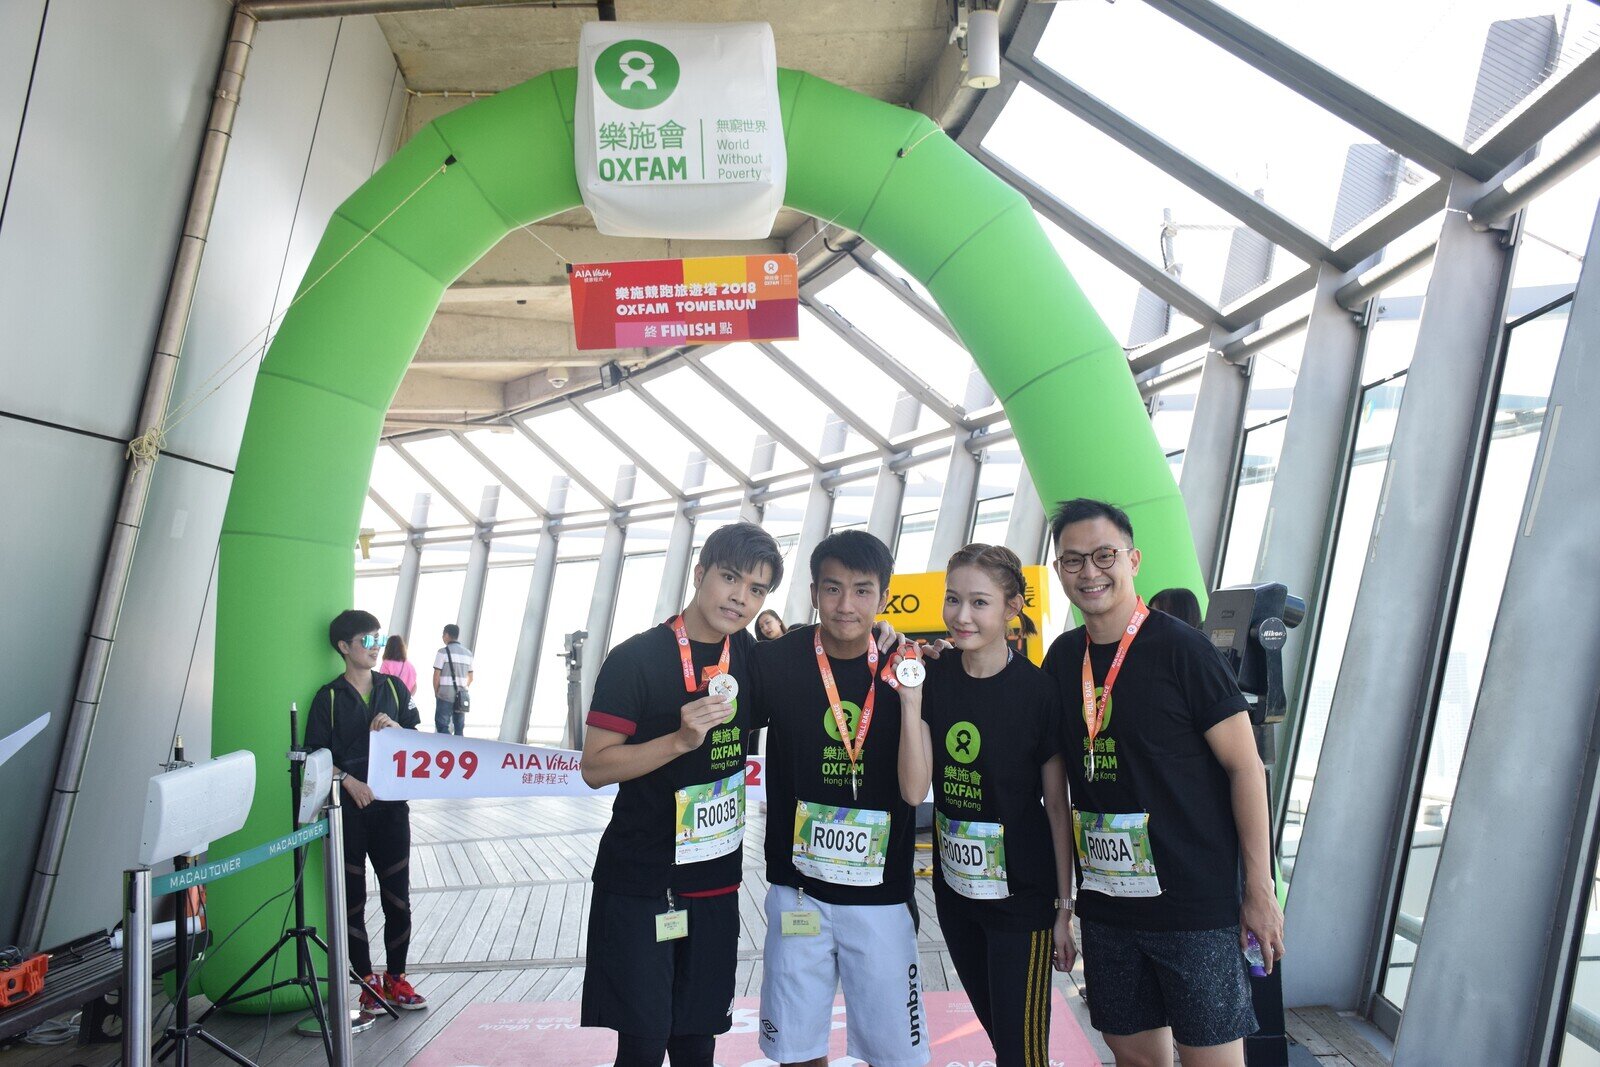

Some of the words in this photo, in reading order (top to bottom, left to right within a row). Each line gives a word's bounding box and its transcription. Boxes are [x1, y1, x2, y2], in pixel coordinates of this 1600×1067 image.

[599, 119, 687, 151] 樂施會
[716, 118, 768, 134] 無窮世界
[717, 139, 750, 150] World
[717, 153, 763, 165] Without
[599, 156, 687, 182] OXFAM
[718, 167, 762, 181] Poverty
[575, 270, 592, 278] AIA
[615, 282, 717, 300] 樂施競跑旅遊塔
[722, 282, 756, 294] 2018
[616, 303, 669, 316] OXFAM
[676, 299, 756, 313] TOWERRUN
[644, 326, 656, 338] 終
[661, 323, 716, 337] FINISH
[720, 322, 732, 334] 點
[1102, 685, 1110, 702] RACE
[833, 703, 842, 720] RACE
[857, 724, 866, 740] FULL
[862, 708, 870, 724] RACE
[712, 726, 740, 745] 樂施會
[711, 743, 742, 760] OXFAM
[393, 750, 478, 780] 1299
[501, 753, 541, 770] AIA
[546, 753, 582, 771] Vitali
[711, 762, 726, 770] Hong
[1084, 755, 1117, 769] OFAM
[522, 773, 568, 785] 健康程式
[745, 761, 761, 785] 2
[824, 777, 842, 786] Hong
[944, 766, 982, 786] 樂施會
[1100, 772, 1116, 782] Kong
[944, 782, 982, 800] OXFAM
[946, 796, 962, 808] Hong
[963, 800, 981, 812] Kong
[697, 798, 736, 829] R003B
[270, 836, 297, 854] MACAU
[298, 824, 324, 842] TOWER
[814, 826, 868, 854] R003C
[943, 837, 983, 866] R003D
[1088, 836, 1132, 862] R003A
[170, 867, 207, 888] MACAU
[208, 858, 240, 876] TOWER
[907, 964, 920, 1047] umbro
